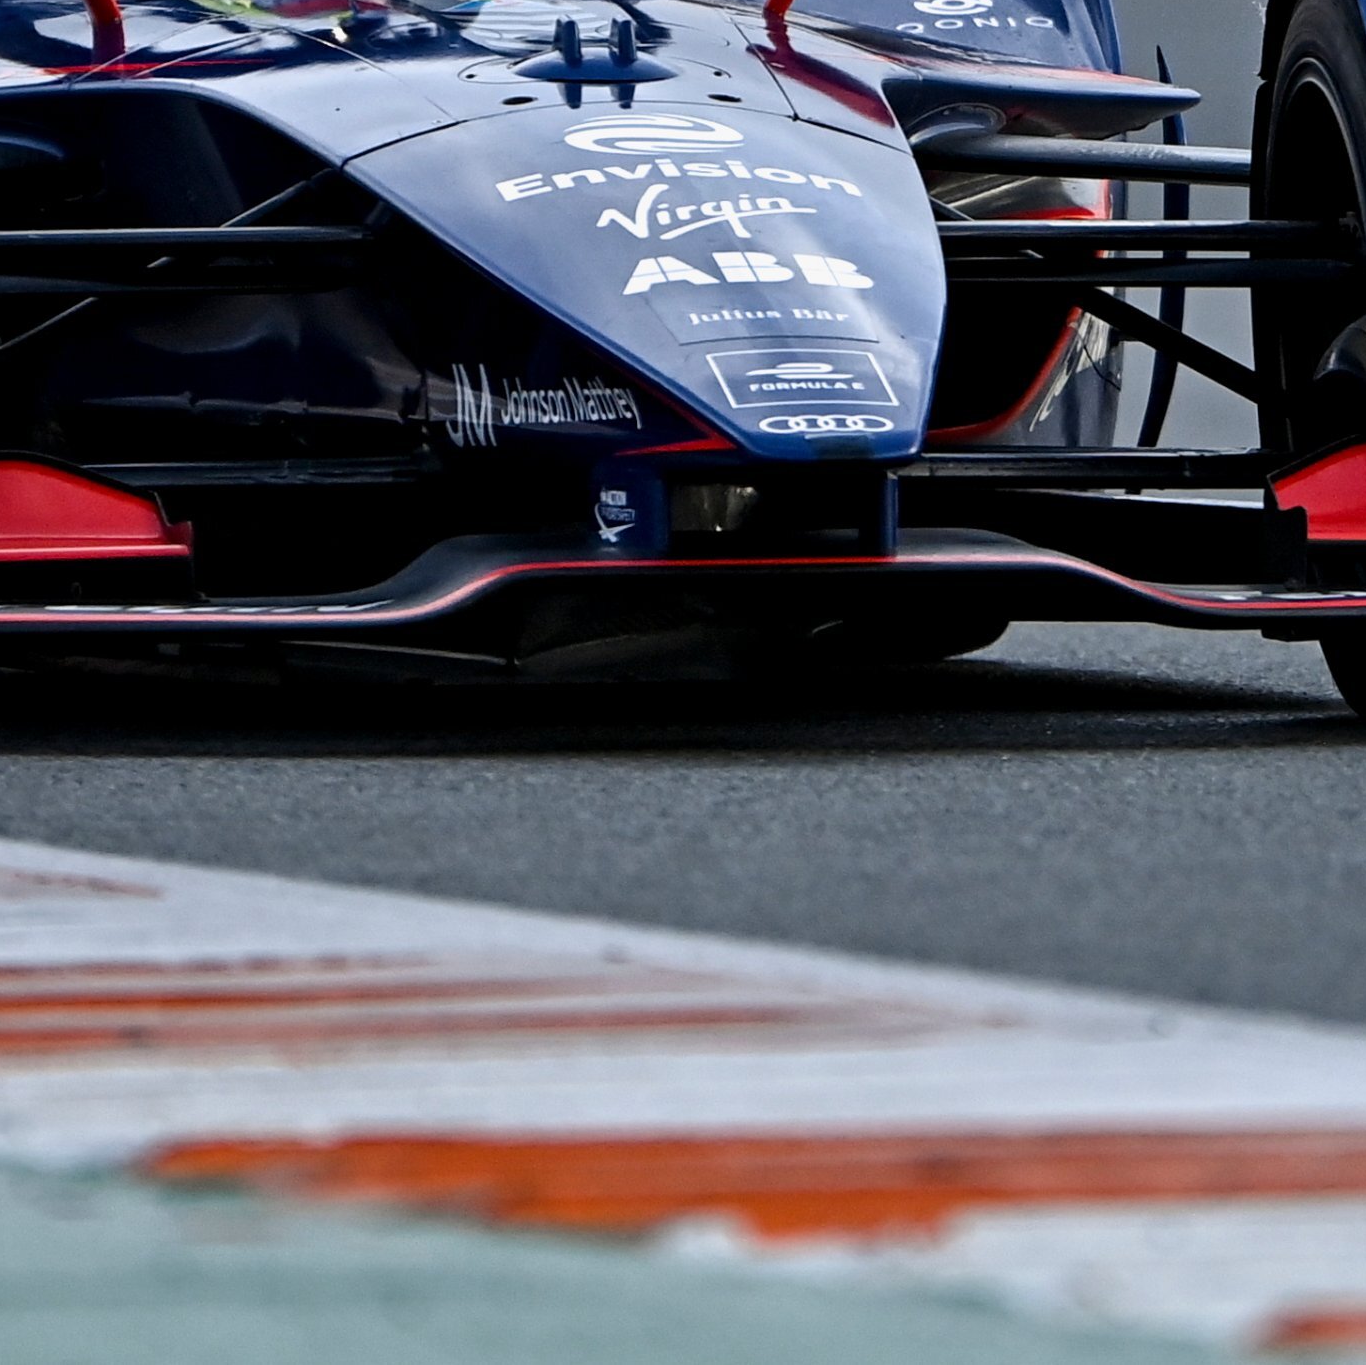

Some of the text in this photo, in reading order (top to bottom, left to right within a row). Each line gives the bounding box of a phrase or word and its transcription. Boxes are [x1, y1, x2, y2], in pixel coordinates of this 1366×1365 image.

[495, 158, 863, 202] Envision
[595, 183, 818, 240] Virgin
[622, 251, 875, 296] ABB
[688, 309, 783, 326] Julius
[501, 377, 573, 425] Johnson
[563, 376, 643, 430] Matthey
[748, 380, 849, 393] FORMULA
